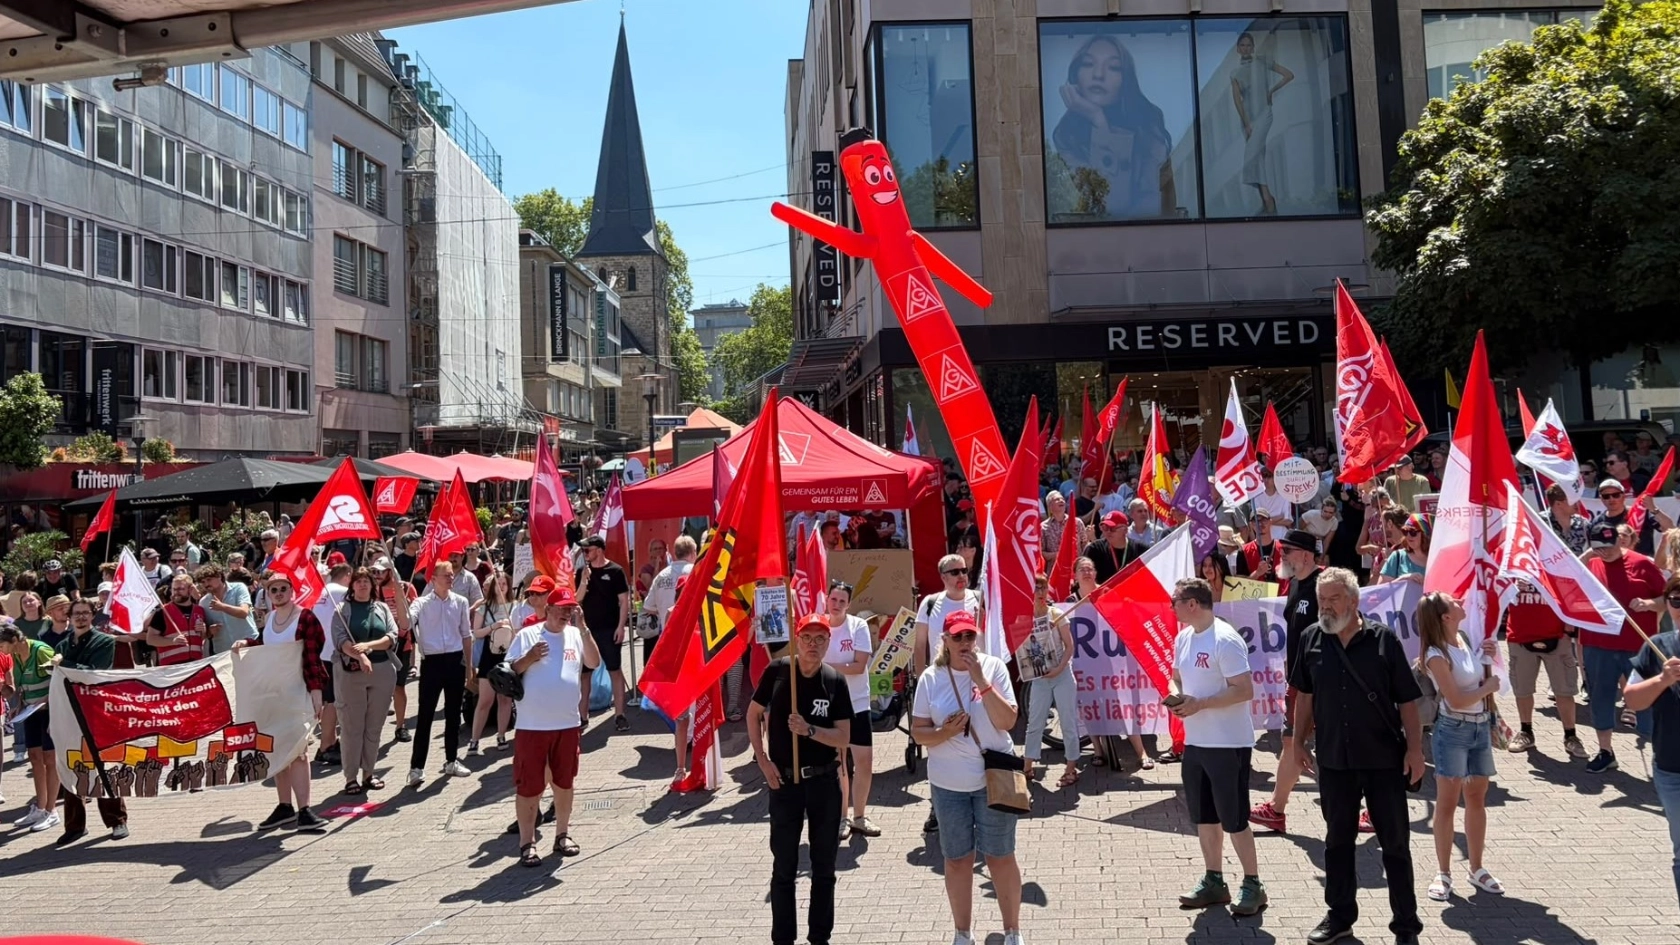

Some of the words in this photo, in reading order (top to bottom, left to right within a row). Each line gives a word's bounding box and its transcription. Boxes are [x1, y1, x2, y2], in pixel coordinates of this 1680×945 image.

[816, 162, 835, 287] RESEVED
[554, 273, 562, 298] LANGE
[555, 306, 563, 354] BRINCKMANN
[1108, 320, 1320, 351] RESERVED
[102, 368, 112, 425] frittenwerk
[782, 487, 829, 496] GEMEINSAM
[830, 485, 845, 495] FÜR
[845, 487, 858, 495] EIN
[811, 496, 835, 504] GUTES
[136, 690, 160, 704] den
[163, 678, 217, 699] Löhnen!
[1076, 671, 1095, 691] Es
[175, 700, 199, 712] den
[1078, 699, 1099, 720] ist
[1106, 698, 1167, 726] längst
[128, 716, 181, 729] Preisen!
